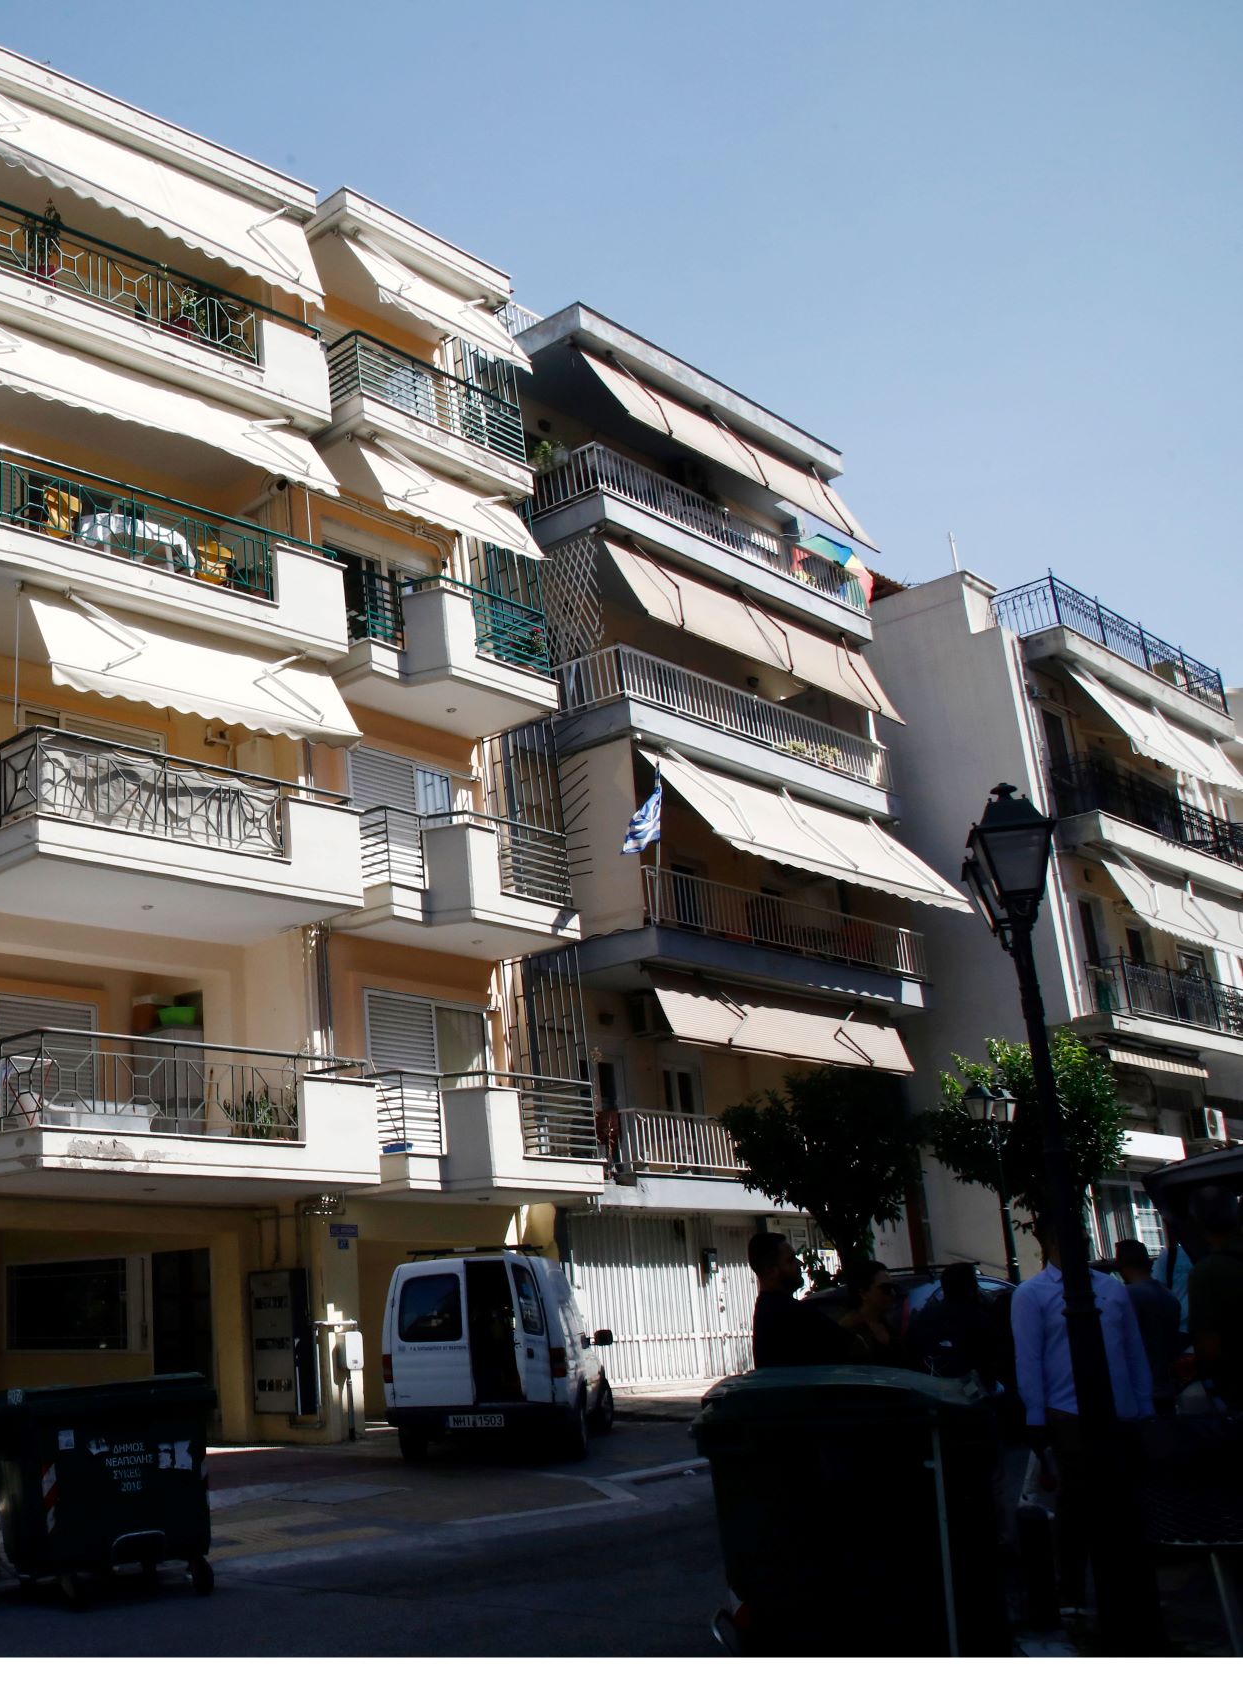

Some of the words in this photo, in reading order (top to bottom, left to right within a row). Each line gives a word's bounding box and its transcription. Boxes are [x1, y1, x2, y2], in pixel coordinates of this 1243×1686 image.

[479, 1414, 503, 1426] 1503
[113, 1442, 146, 1454] ΔΗΜΟΣ
[105, 1454, 154, 1467] ΝΕΑΠΟΛΗΣ
